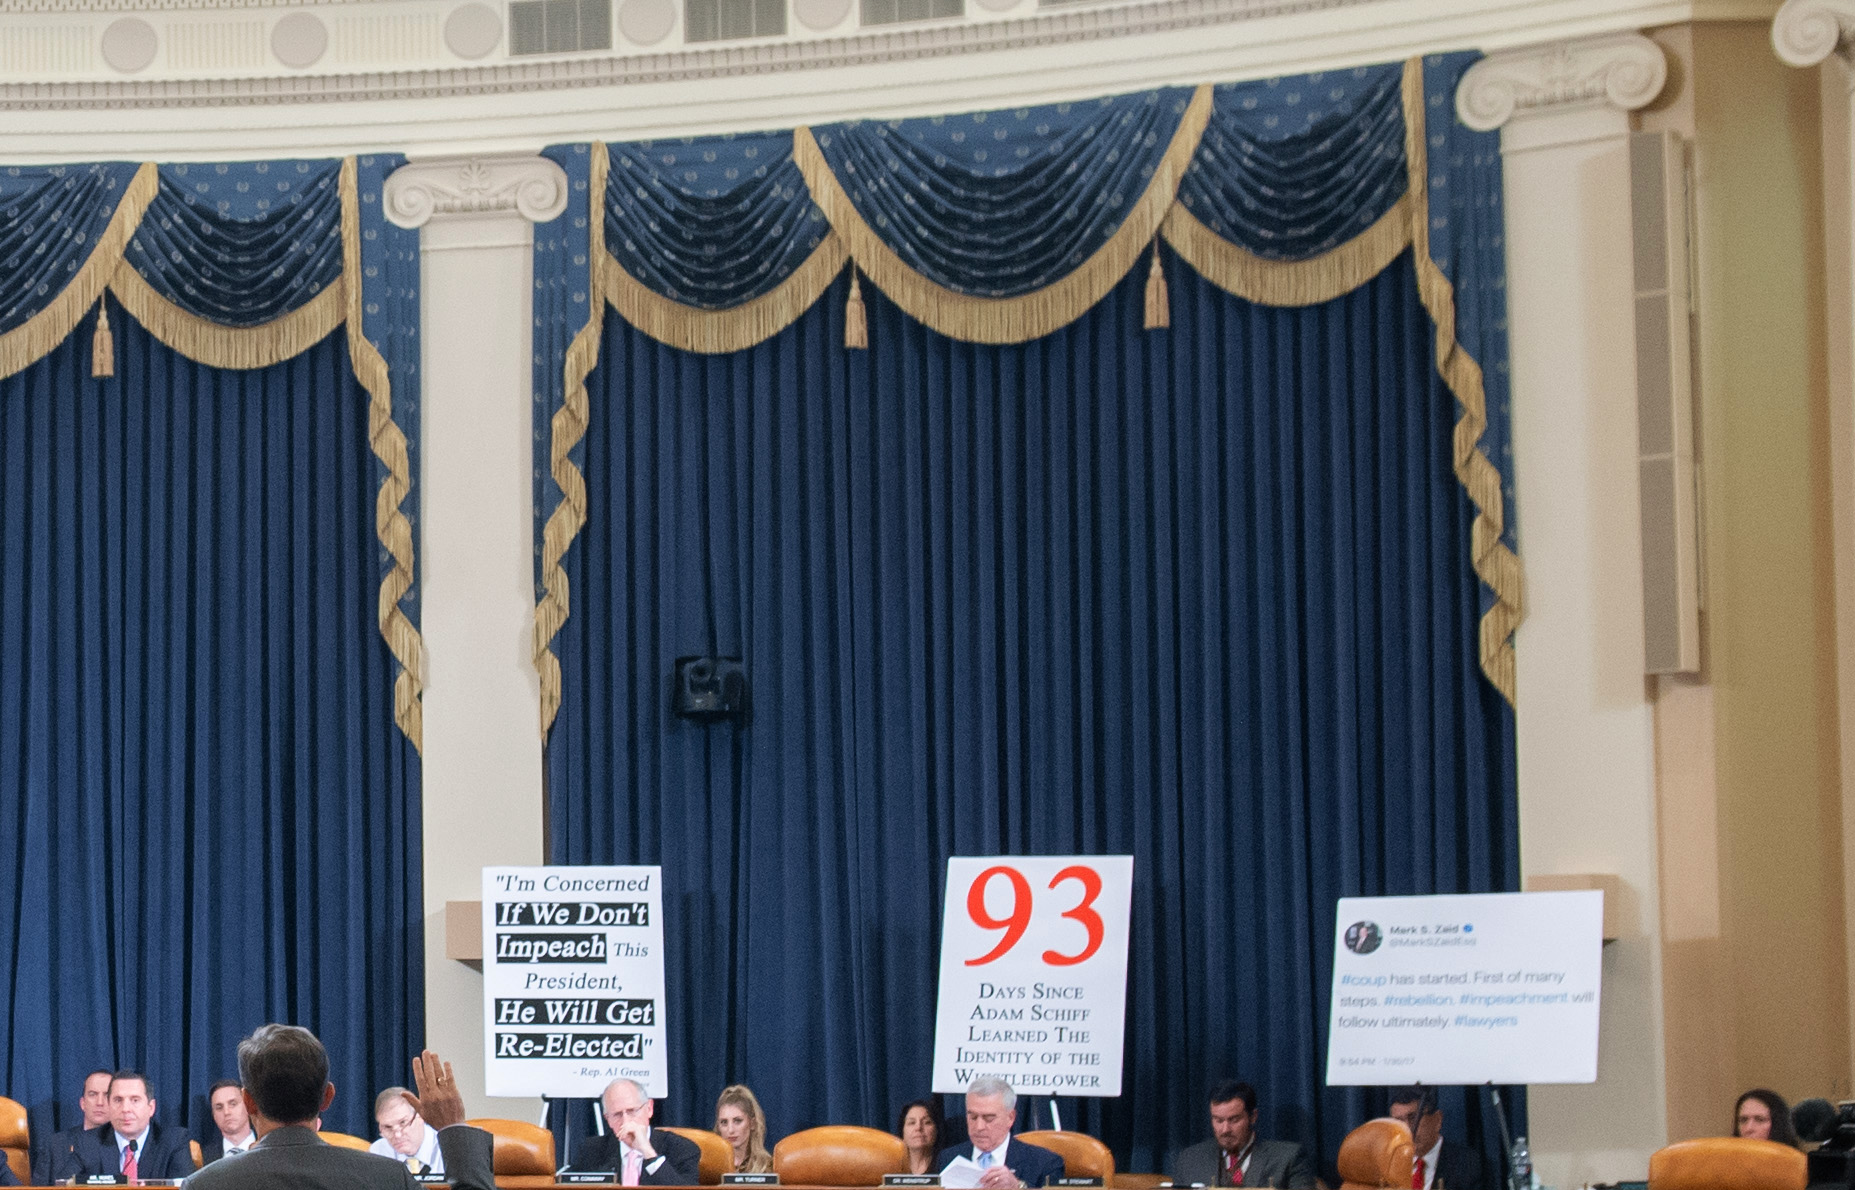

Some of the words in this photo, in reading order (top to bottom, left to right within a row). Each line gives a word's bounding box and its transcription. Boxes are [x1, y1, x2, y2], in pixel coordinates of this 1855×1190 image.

[496, 875, 535, 892] "I'm
[544, 875, 650, 892] Concerned
[499, 903, 527, 925] If
[531, 903, 570, 925] We
[576, 903, 648, 925] Don't
[964, 865, 1105, 967] 93
[1389, 925, 1417, 935] Mark
[1434, 924, 1460, 935] Zaid
[497, 934, 606, 963] Impeach
[613, 942, 649, 957] This
[524, 972, 623, 993] President,
[1341, 974, 1387, 988] #coup
[1389, 973, 1415, 985] has
[1473, 970, 1504, 984] First
[1507, 969, 1523, 984] of
[1525, 971, 1566, 985] many
[1460, 992, 1568, 1008] #impeachment
[1571, 990, 1595, 1003] will
[497, 1000, 536, 1024] He
[544, 1000, 598, 1024] Will
[606, 1000, 653, 1024] Get
[1338, 1015, 1380, 1028] follow
[1454, 1014, 1518, 1030] #lawyers
[497, 1033, 653, 1058] Re-Elected"
[580, 1067, 603, 1079] Rep.
[606, 1067, 618, 1078] Al
[620, 1067, 650, 1078] Green
